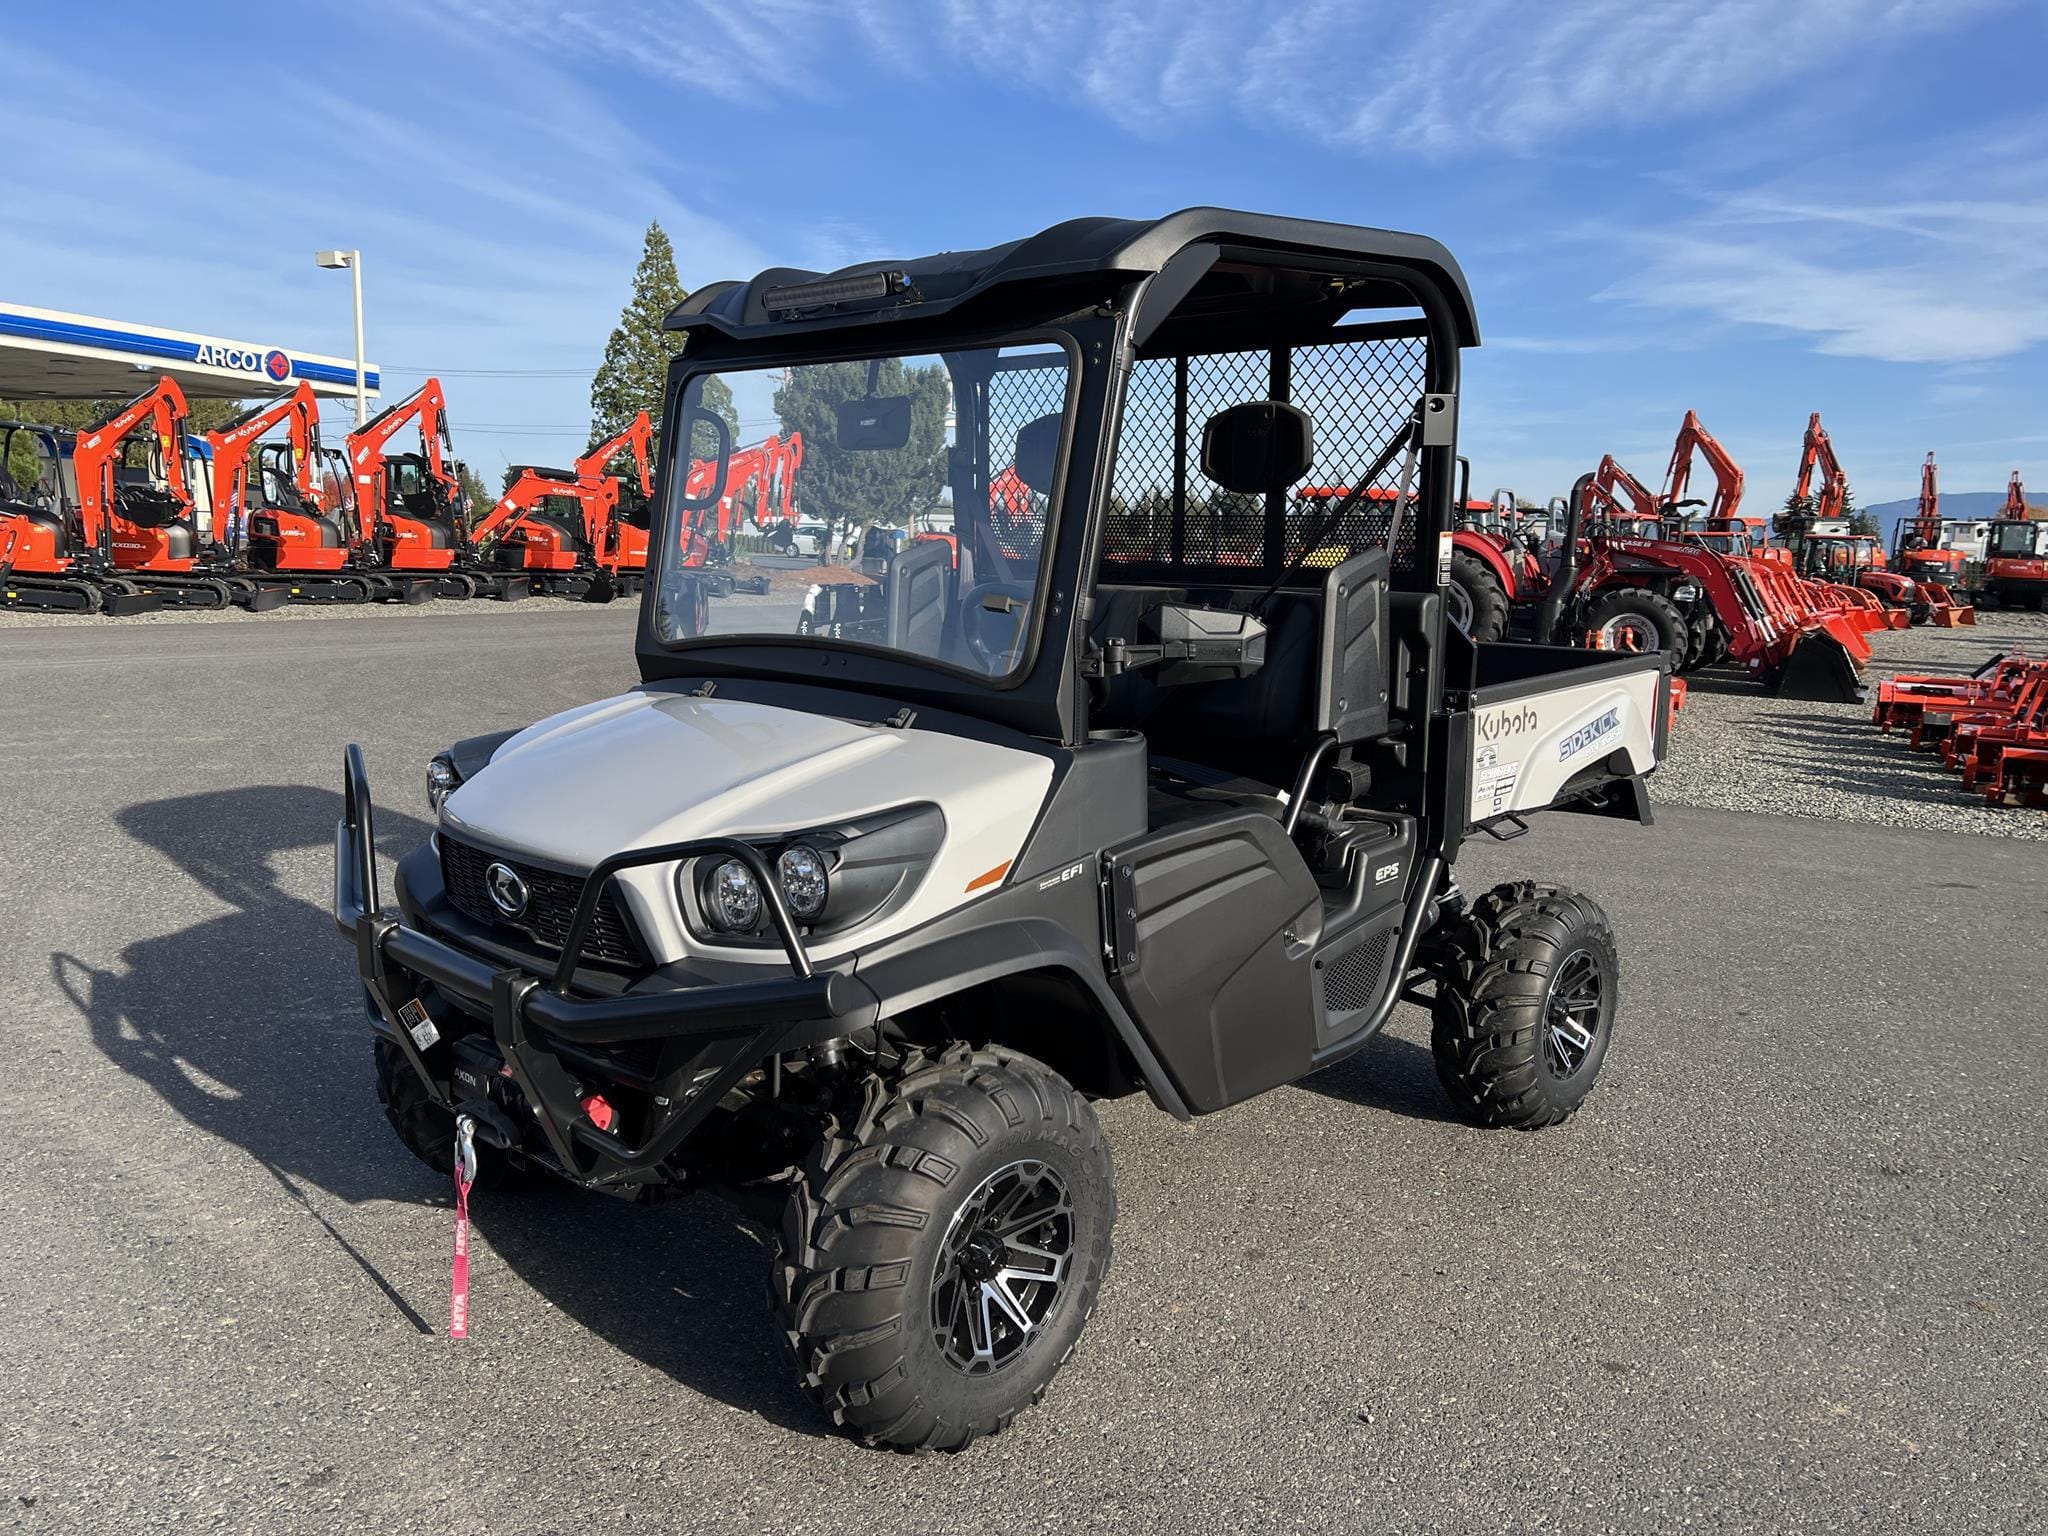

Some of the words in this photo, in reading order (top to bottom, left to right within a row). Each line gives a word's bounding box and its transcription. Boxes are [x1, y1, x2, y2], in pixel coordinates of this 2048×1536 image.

[195, 344, 257, 371] ARCO
[237, 420, 268, 437] Kubota
[380, 417, 404, 436] Kubota
[1477, 705, 1538, 741] Kubota
[1560, 708, 1620, 762] SIDEKICK
[1061, 863, 1083, 881] EFI
[1375, 862, 1400, 881] EPS
[454, 1067, 477, 1087] AXON
[455, 1219, 466, 1256] WARN
[453, 1293, 466, 1331] WARN
